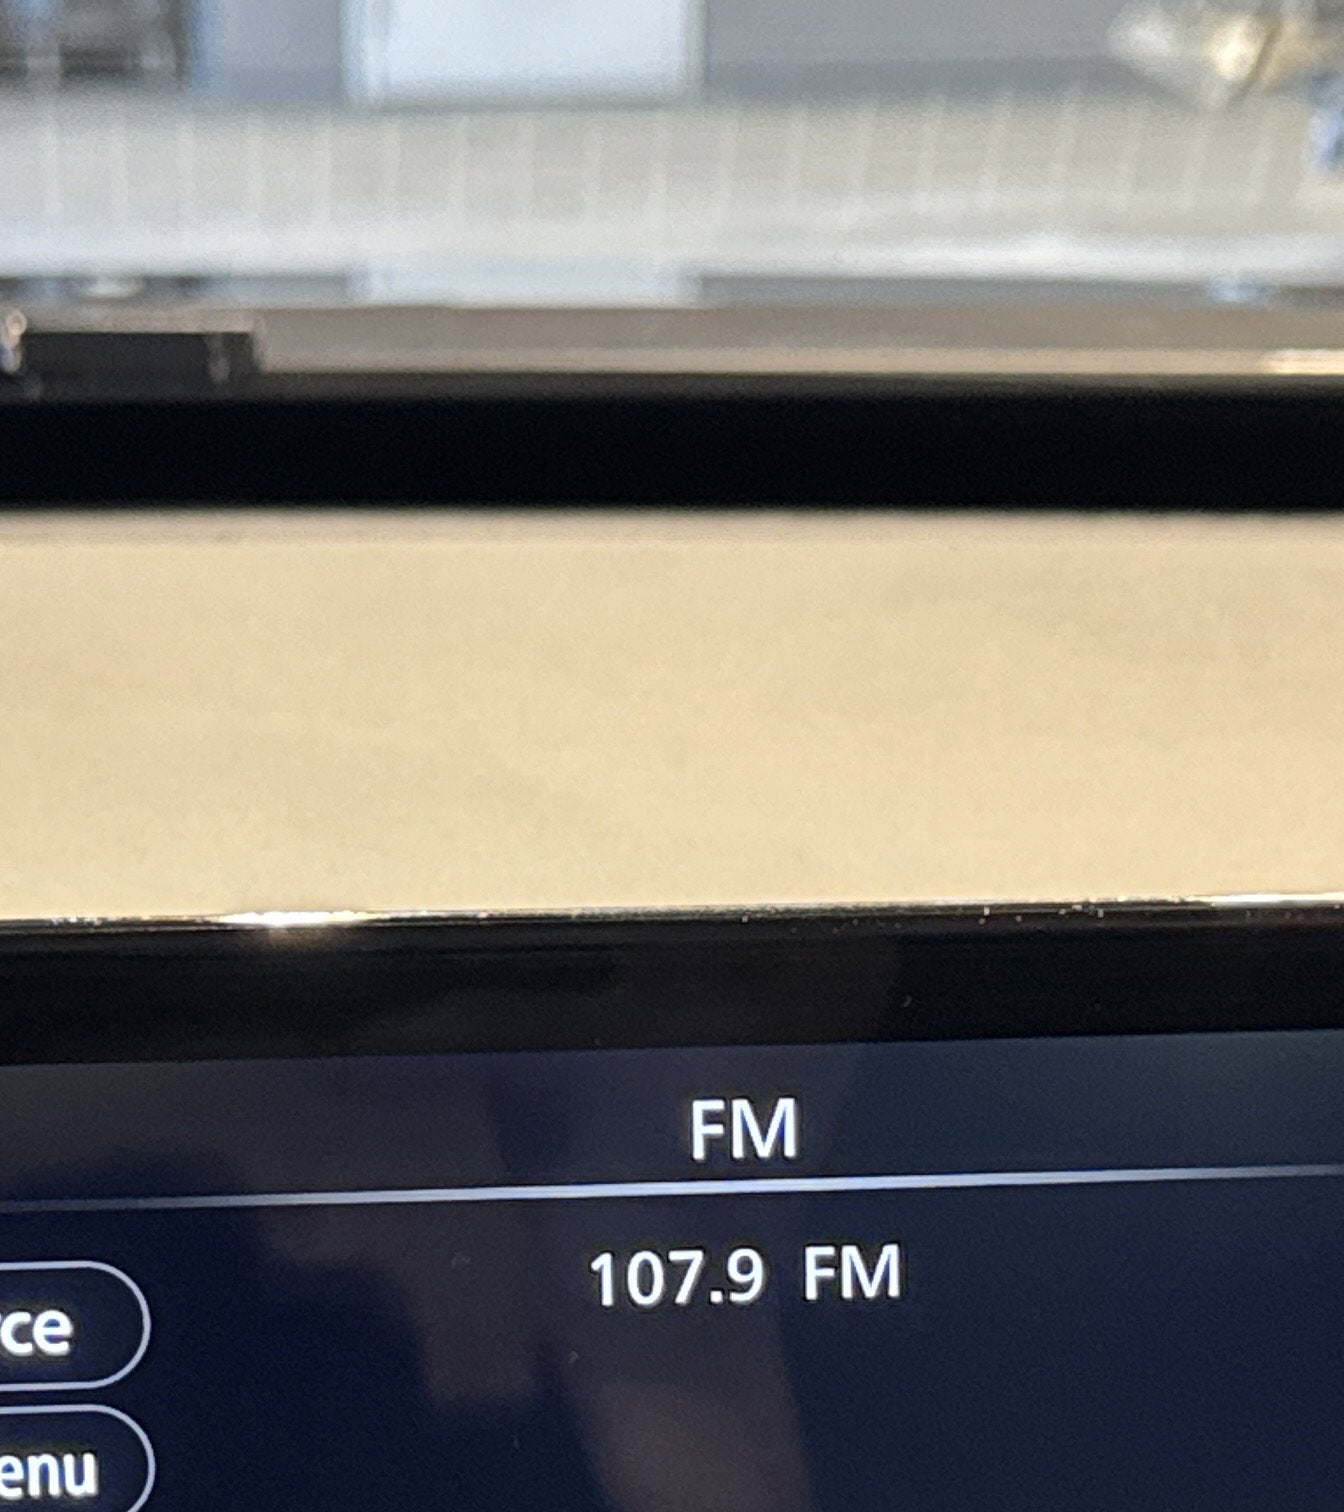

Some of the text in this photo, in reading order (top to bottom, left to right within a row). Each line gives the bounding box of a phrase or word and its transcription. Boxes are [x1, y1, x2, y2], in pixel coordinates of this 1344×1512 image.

[692, 1097, 796, 1160] FM
[590, 1244, 900, 1307] 107.9 FM
